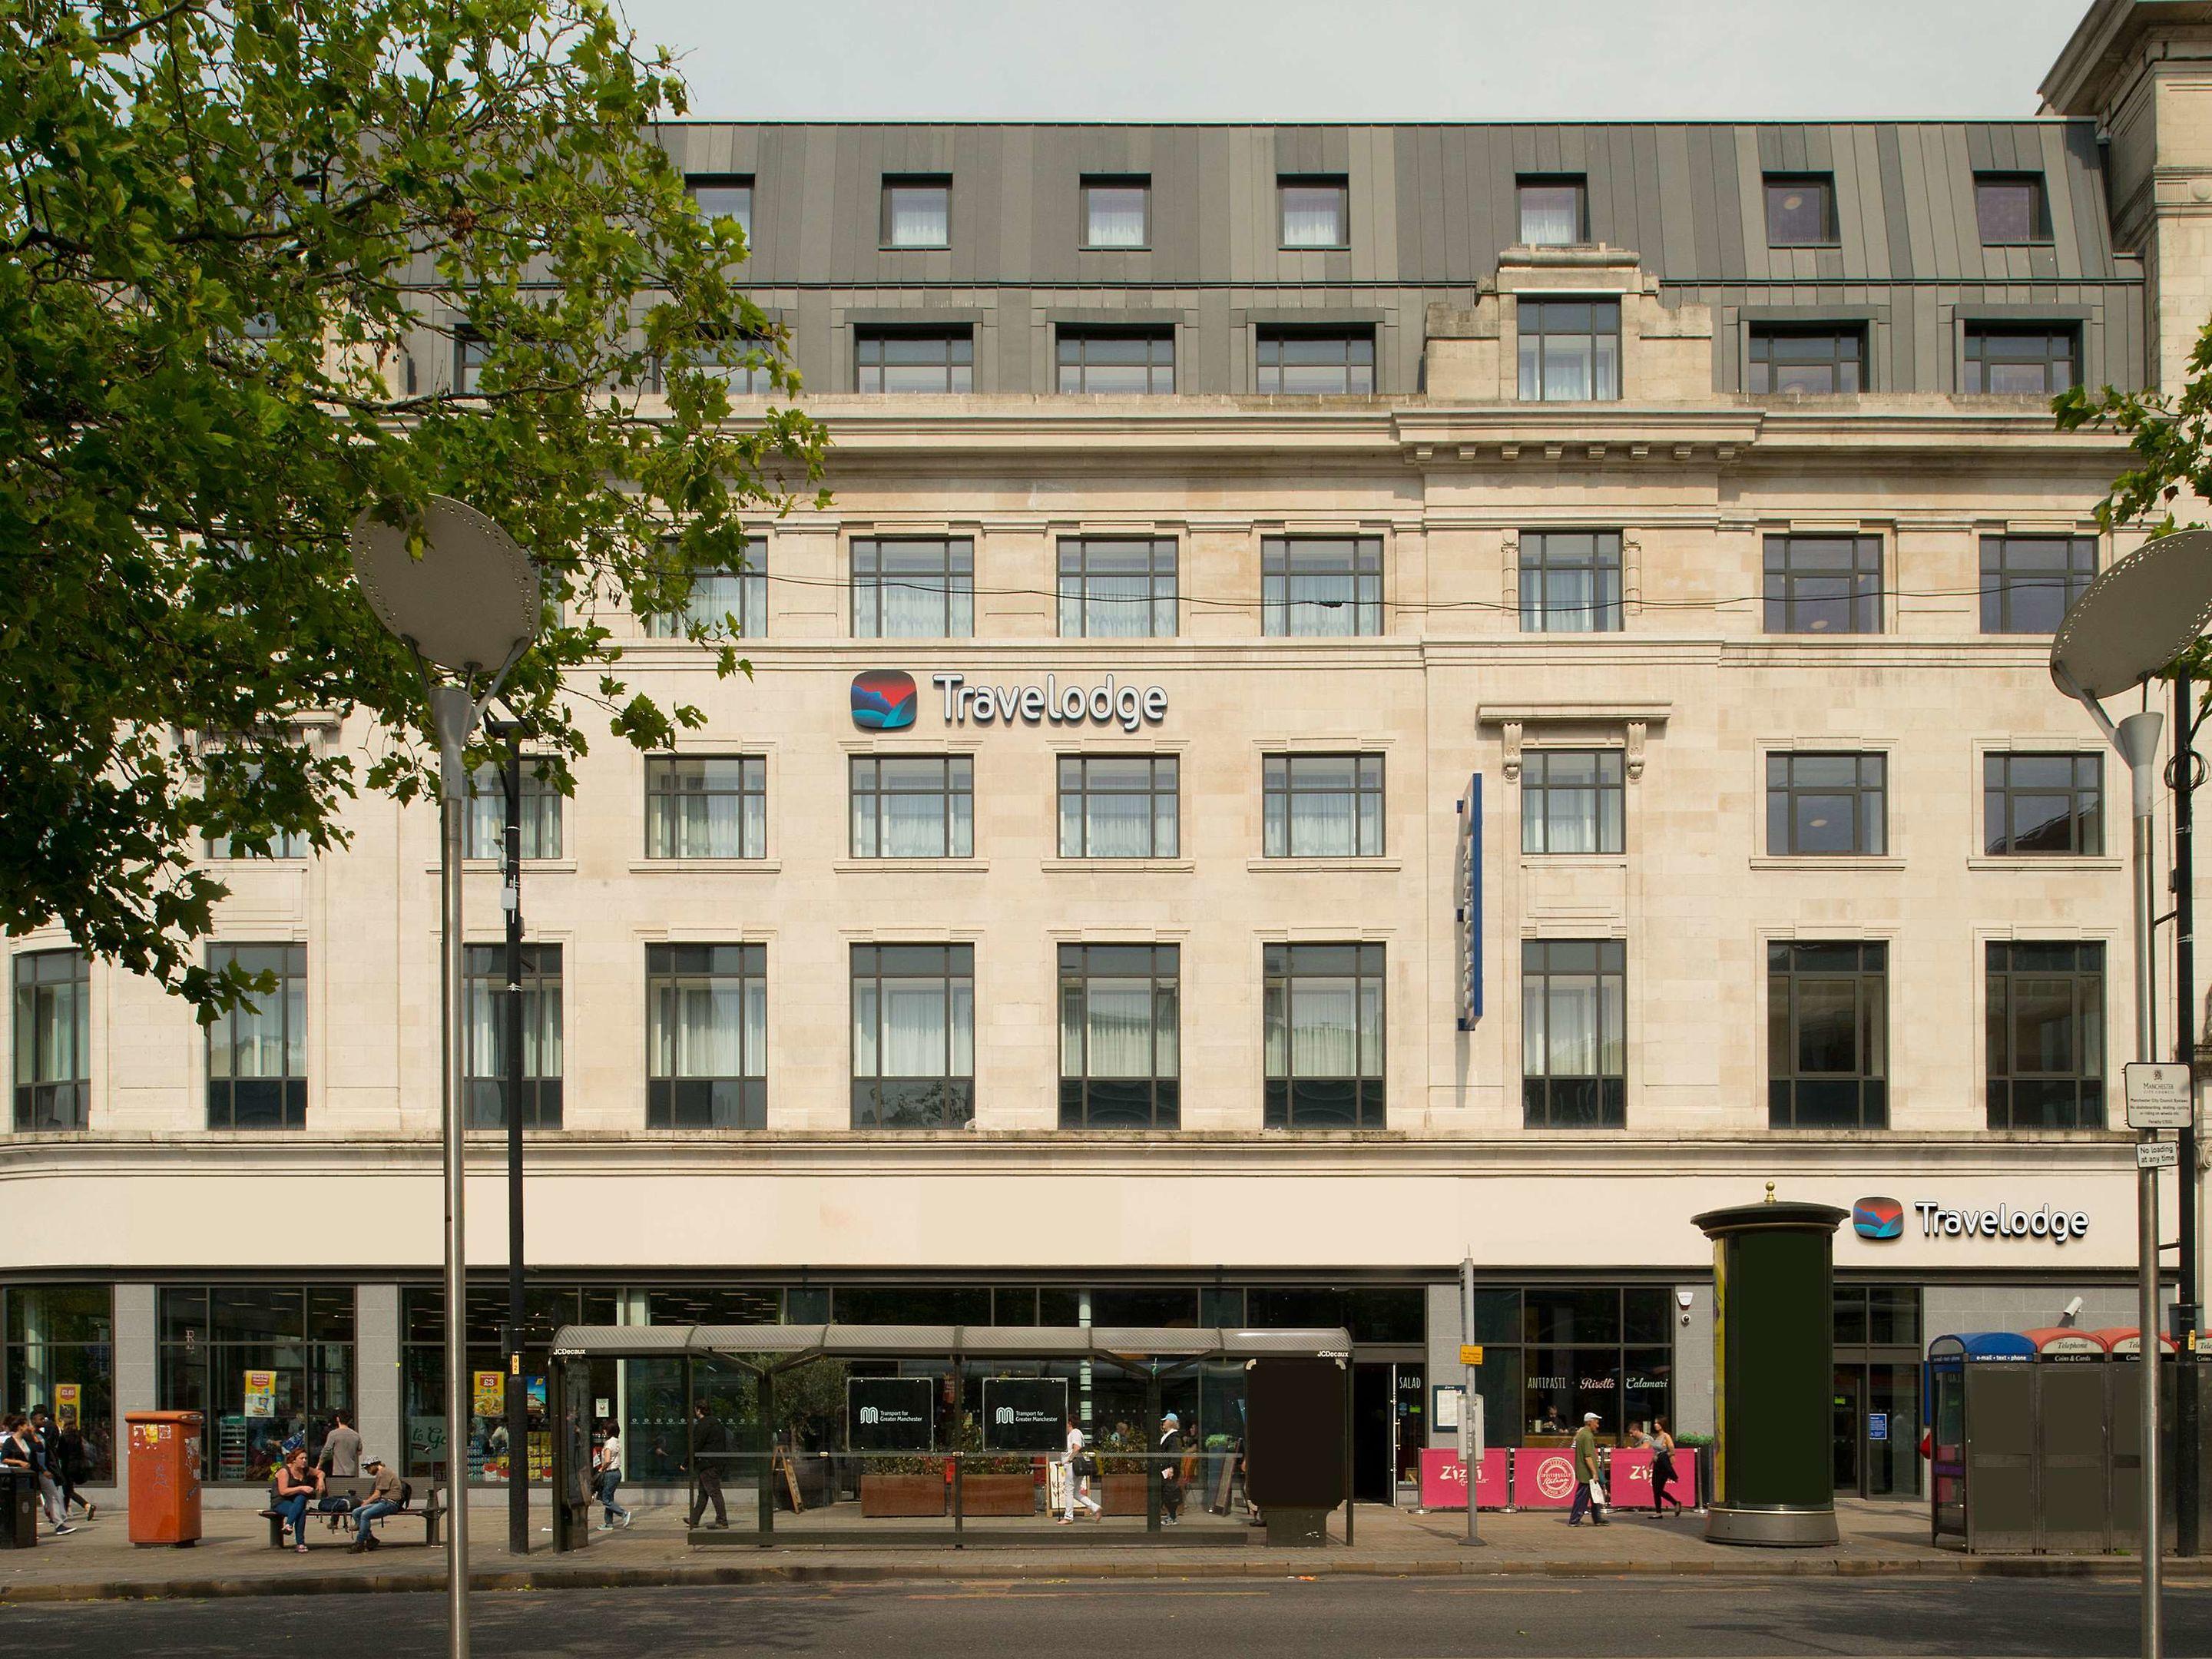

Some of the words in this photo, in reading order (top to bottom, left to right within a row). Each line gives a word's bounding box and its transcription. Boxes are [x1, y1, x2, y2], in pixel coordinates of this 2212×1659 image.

[932, 674, 1168, 732] Travelodge
[1915, 1201, 2089, 1244] Travelodge
[2058, 1340, 2088, 1349] Telephone
[1399, 1377, 1421, 1389] SALAD
[1528, 1377, 1566, 1389] ANTIPASTI
[1580, 1377, 1615, 1389] Risotto
[1625, 1377, 1668, 1389] Calamari
[1440, 1465, 1482, 1480] Zizi
